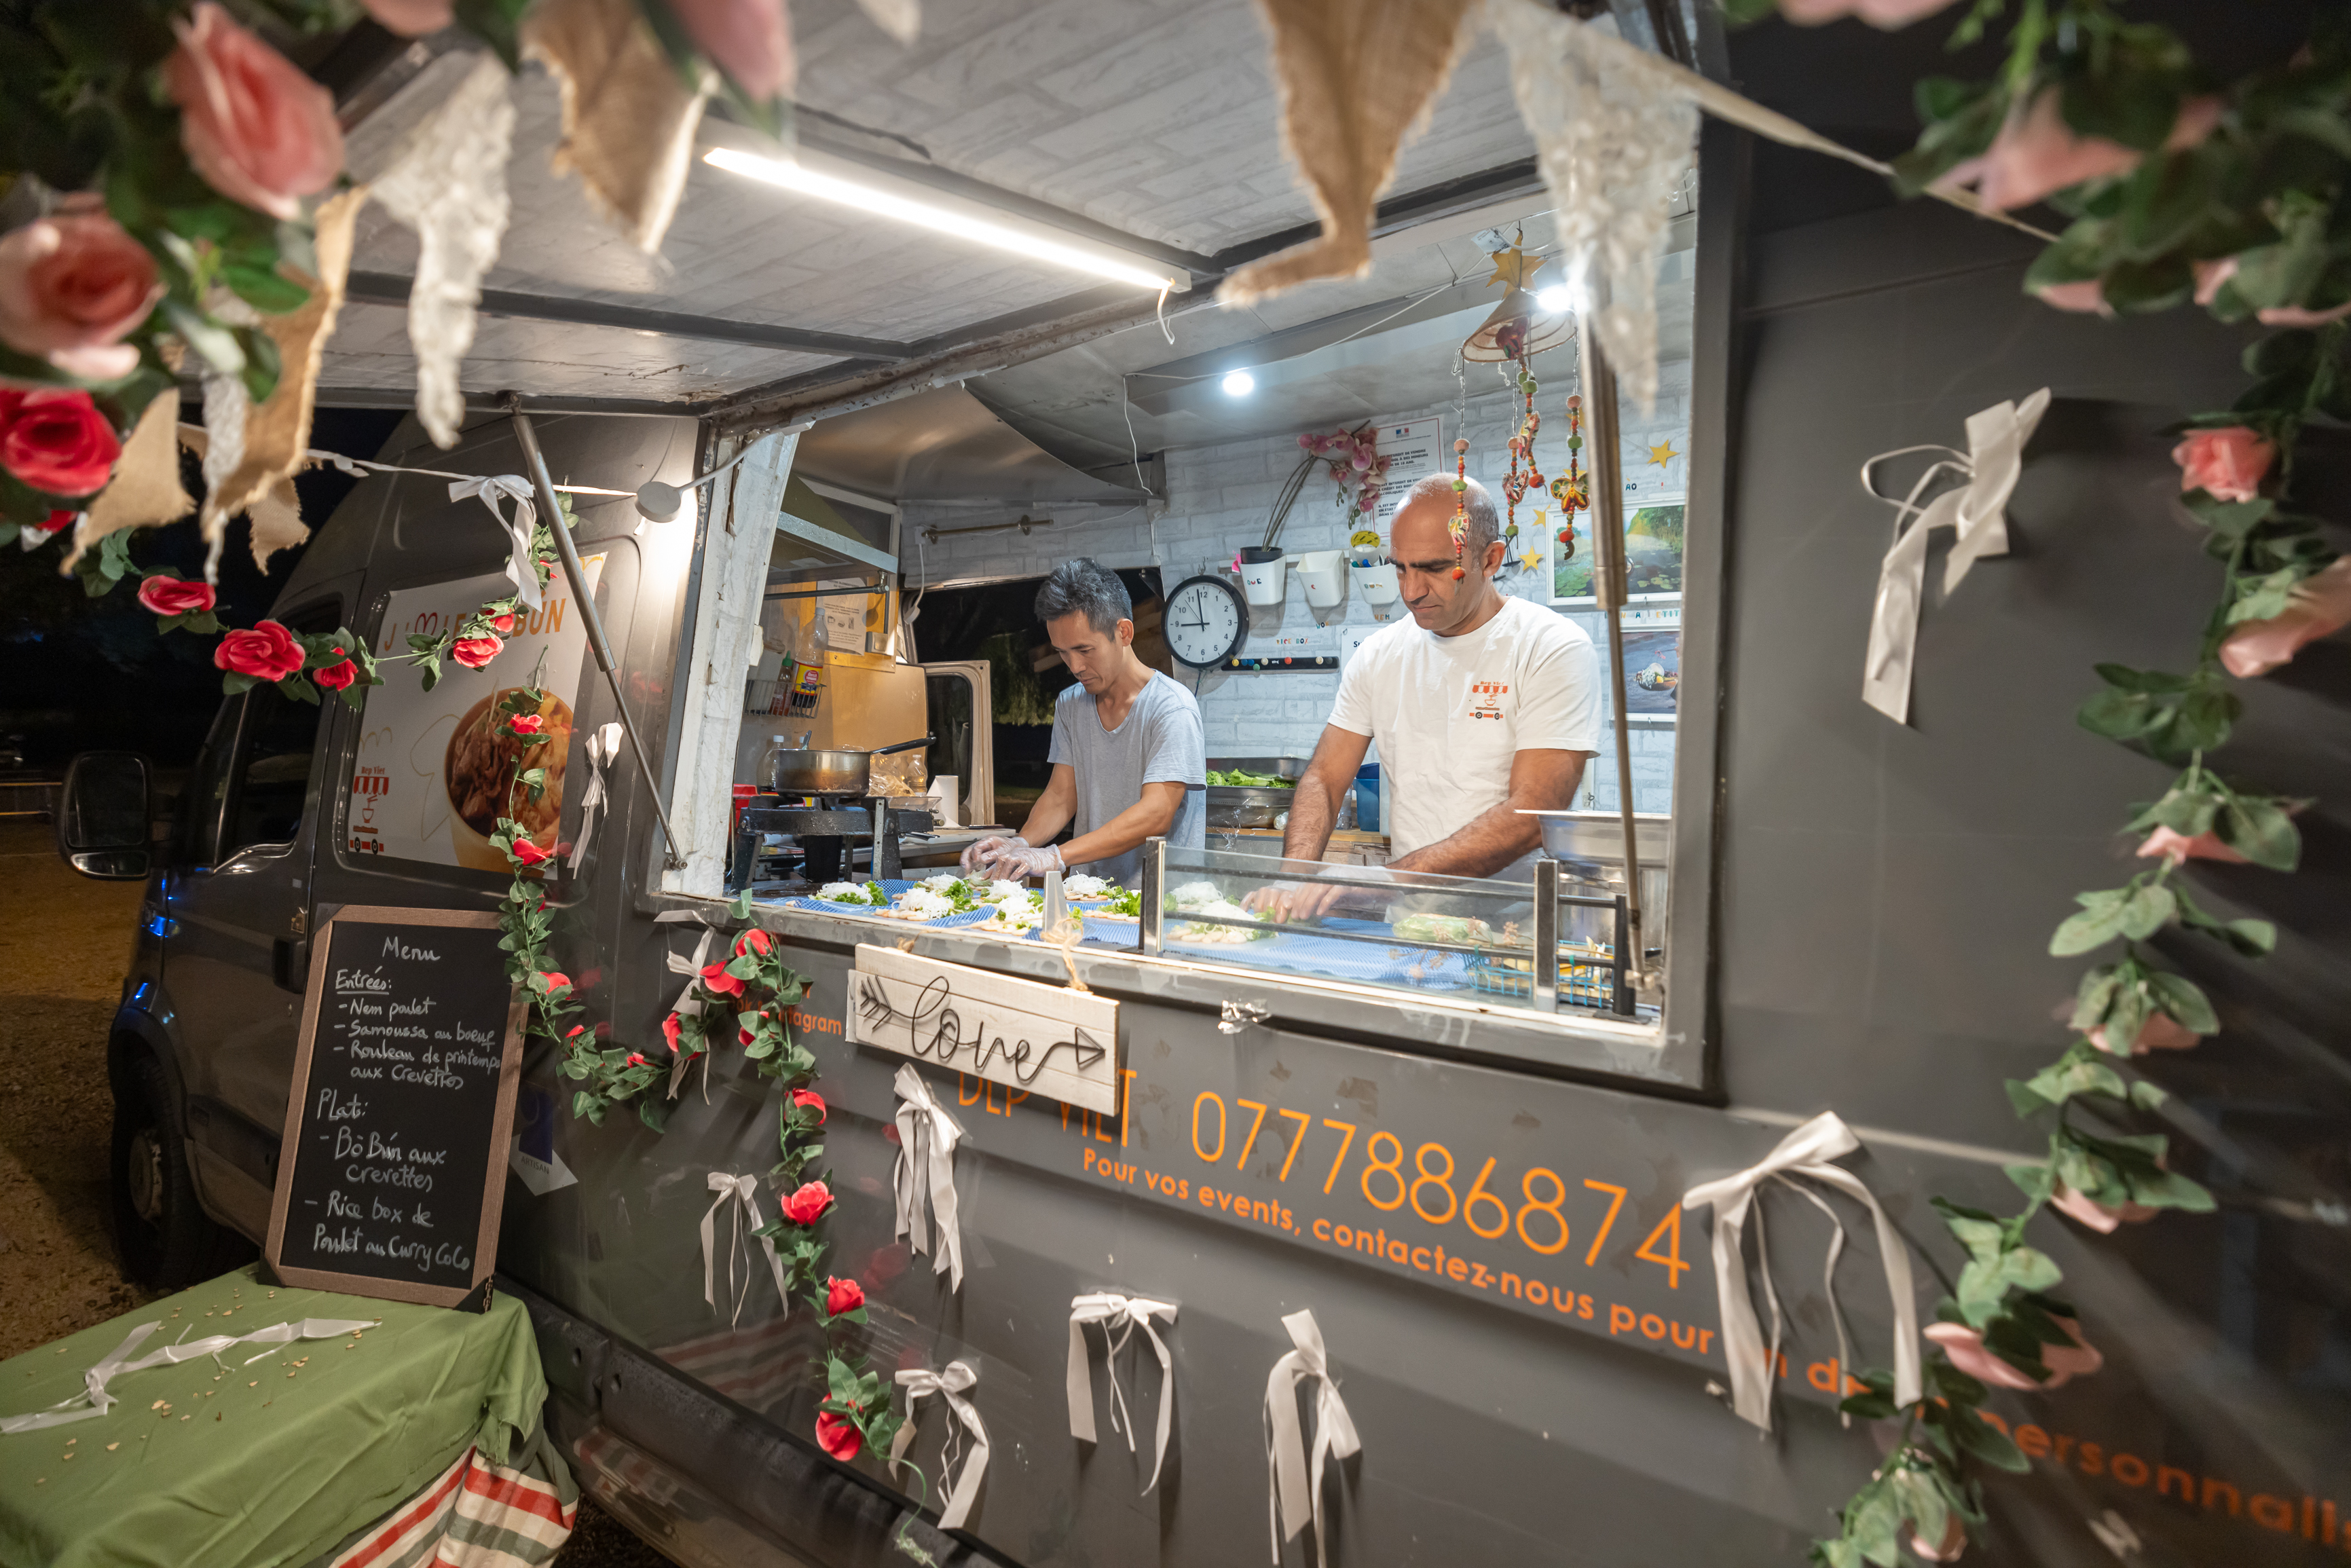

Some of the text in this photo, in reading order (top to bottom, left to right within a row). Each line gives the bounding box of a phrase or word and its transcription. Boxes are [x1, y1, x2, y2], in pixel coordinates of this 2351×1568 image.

[382, 936, 441, 960] Menu
[350, 996, 437, 1022] Nem poulet
[348, 1020, 428, 1039] Samoussa
[434, 1030, 452, 1040] au
[351, 1039, 415, 1062] Rouleau
[422, 1045, 440, 1064] de
[350, 1066, 383, 1079] aux
[409, 1149, 447, 1165] aux
[521, 1155, 550, 1175] ARTISAN
[1191, 1091, 1690, 1289] 0777886874
[327, 1190, 434, 1228] Rice box de
[313, 1222, 363, 1254] Poulet
[365, 1242, 386, 1256] au
[1084, 1147, 1138, 1184] Pour
[1145, 1170, 1189, 1200] vos
[1198, 1186, 1301, 1237] events,
[1312, 1218, 1595, 1320] contactez-nous
[1610, 1303, 1715, 1355] pour
